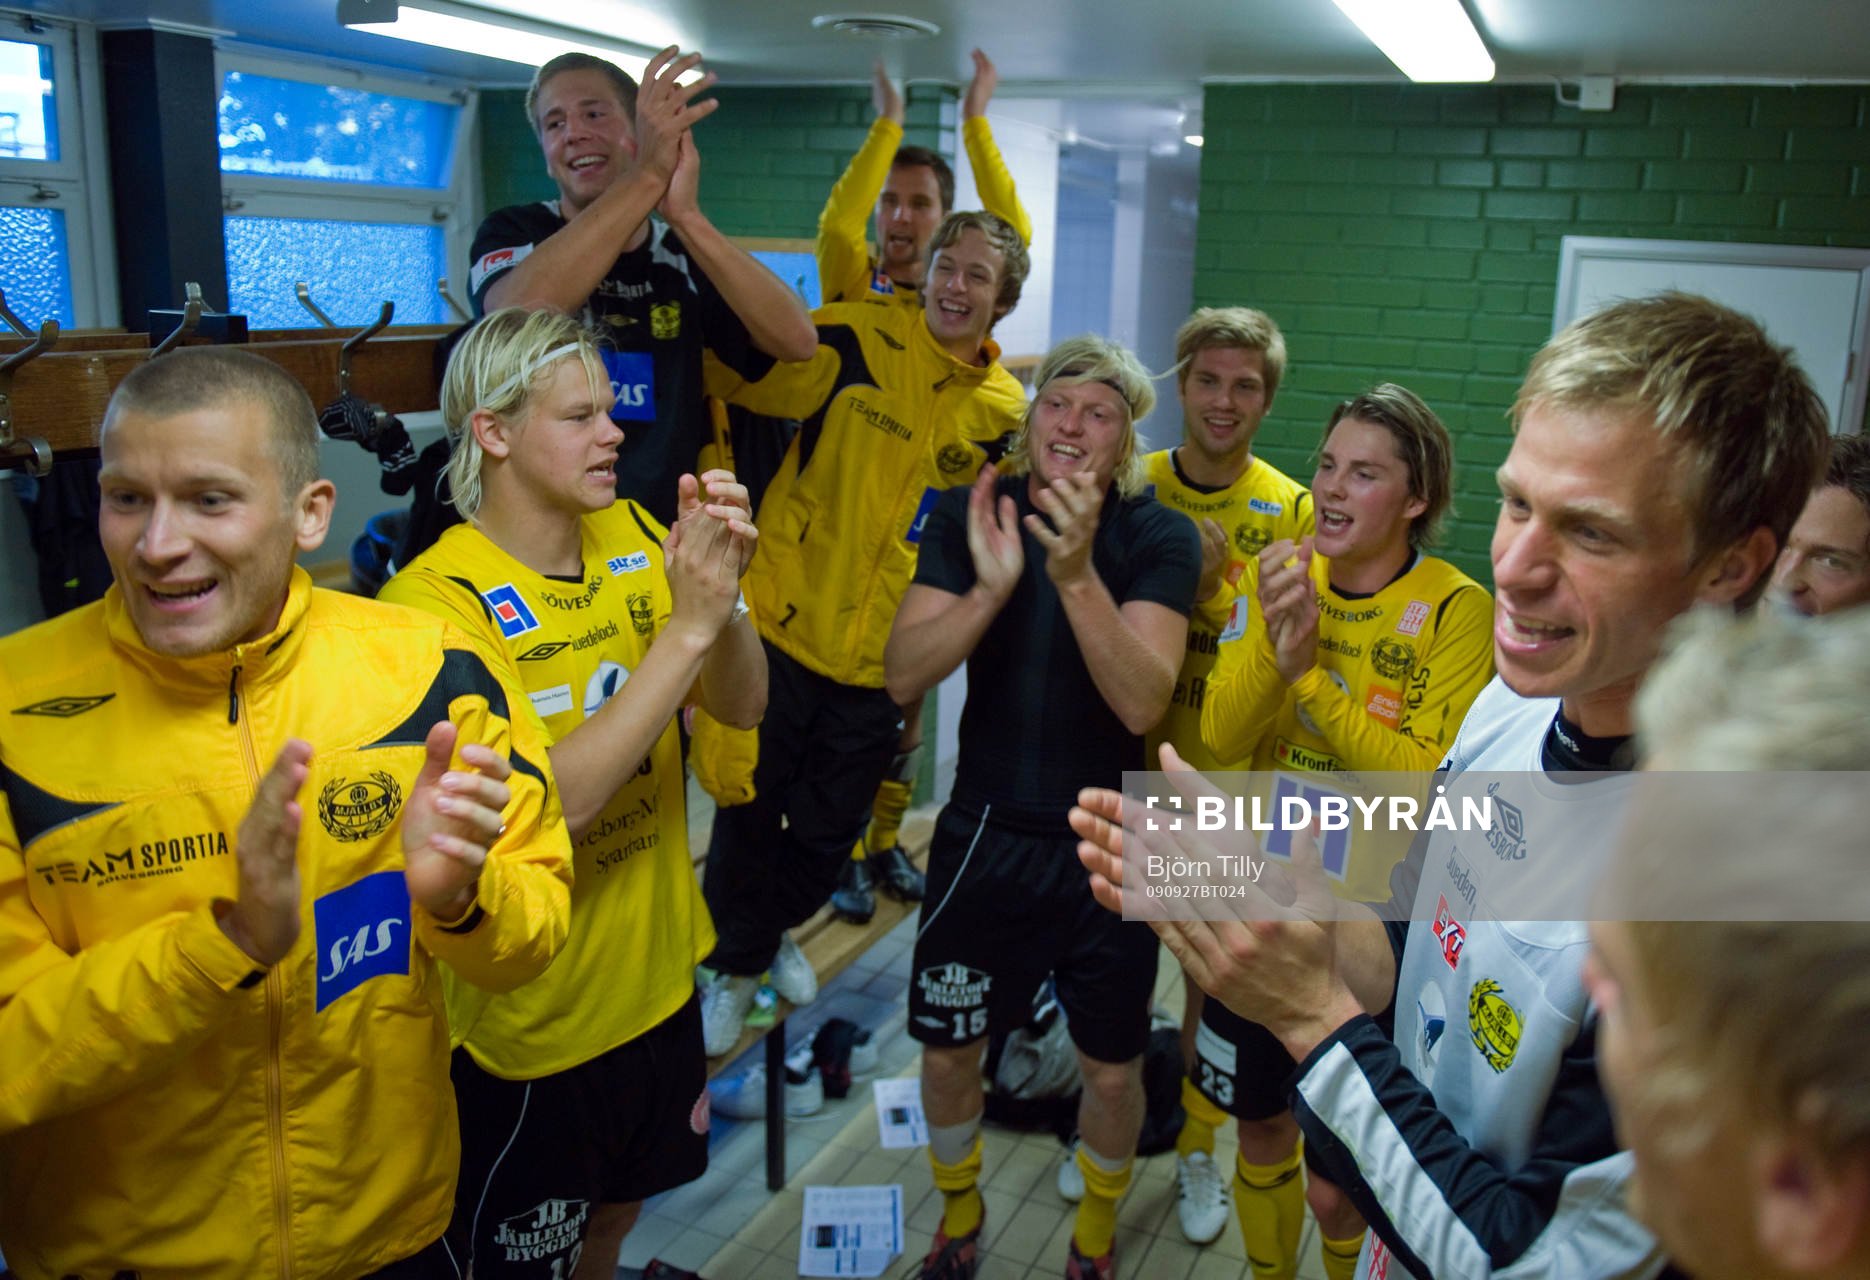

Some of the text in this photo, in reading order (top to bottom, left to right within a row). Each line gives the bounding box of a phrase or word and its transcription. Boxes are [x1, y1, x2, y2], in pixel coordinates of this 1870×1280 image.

[35, 832, 229, 886] TEAM SPORTIA
[321, 918, 403, 983] SAS
[1201, 1063, 1235, 1106] 23
[531, 1201, 567, 1229] JB
